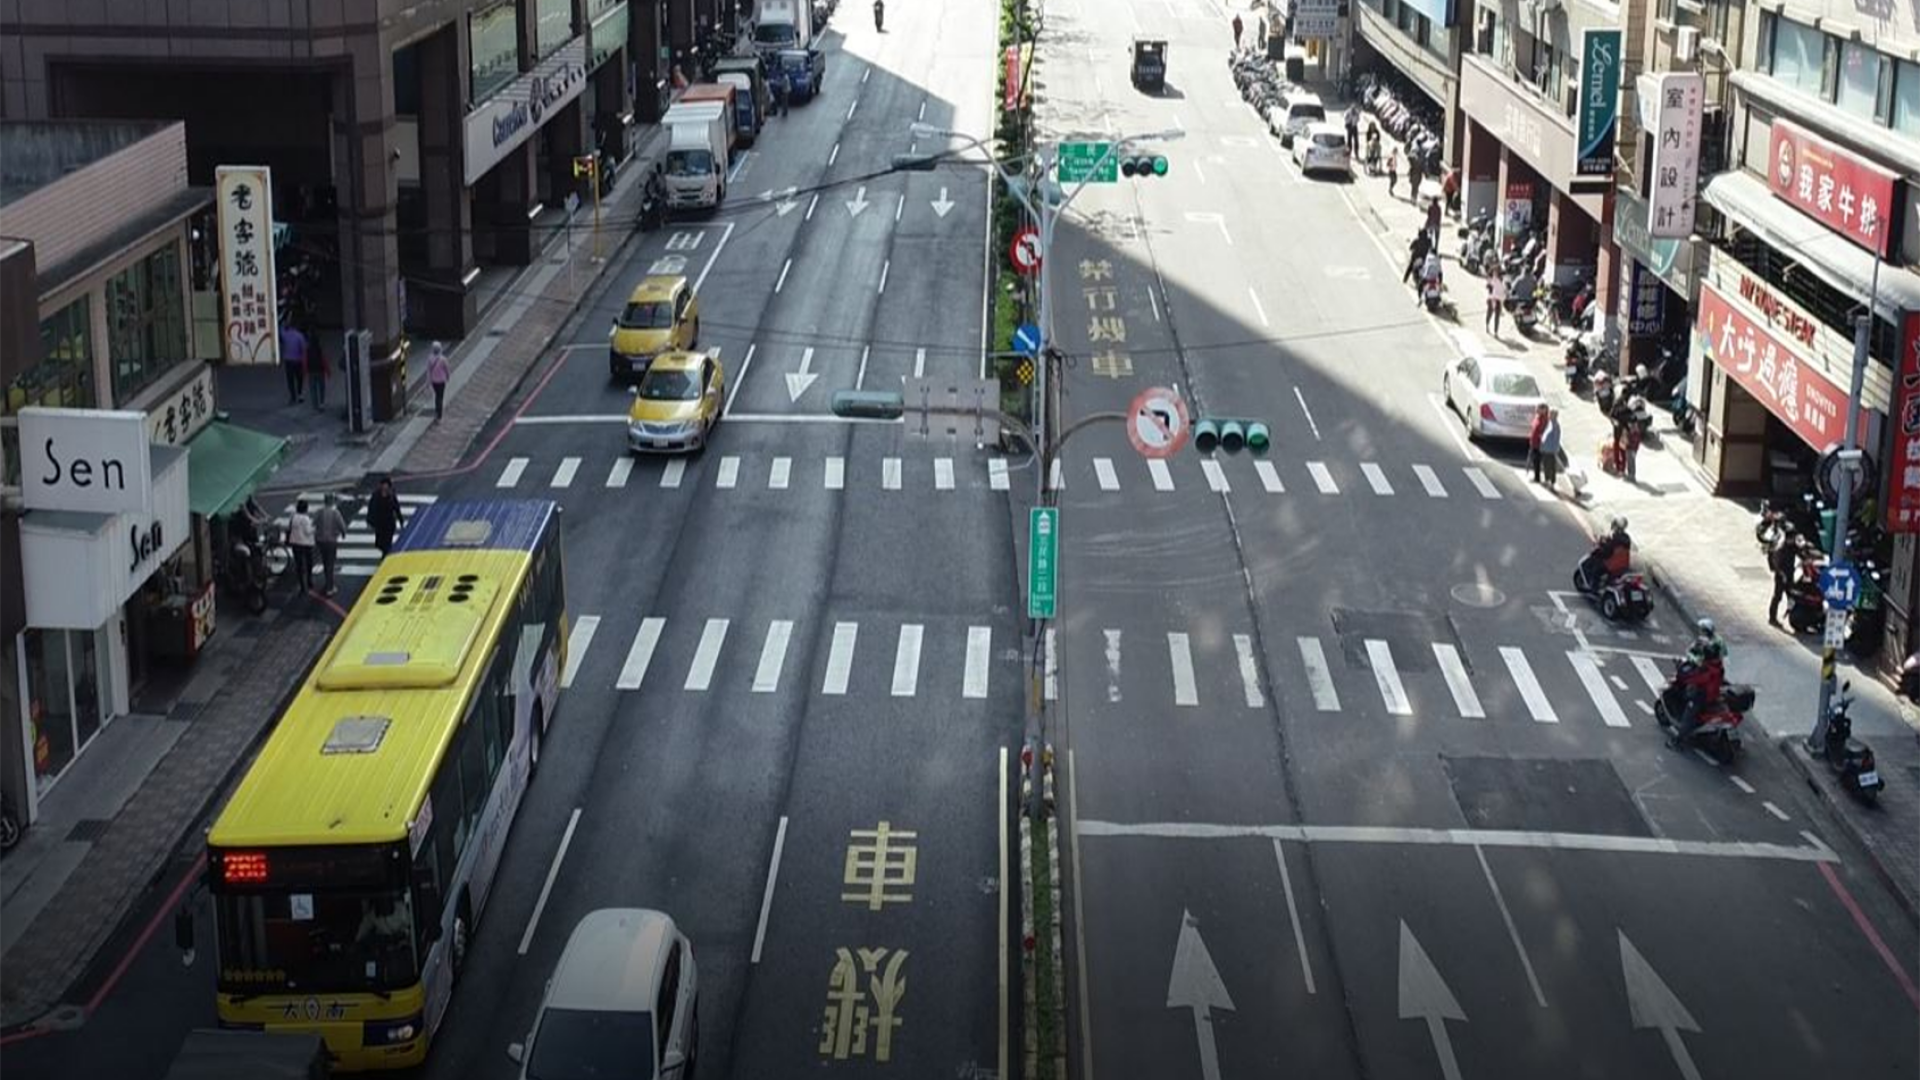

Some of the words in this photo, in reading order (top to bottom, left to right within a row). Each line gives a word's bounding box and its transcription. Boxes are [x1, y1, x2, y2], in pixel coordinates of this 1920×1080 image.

[1657, 88, 1684, 228] 室內設計
[231, 184, 259, 277] 老字號
[1800, 164, 1877, 237] 我家牛排
[1079, 259, 1134, 379] 禁行機車
[42, 437, 124, 490] Sen
[130, 520, 163, 573] Sen
